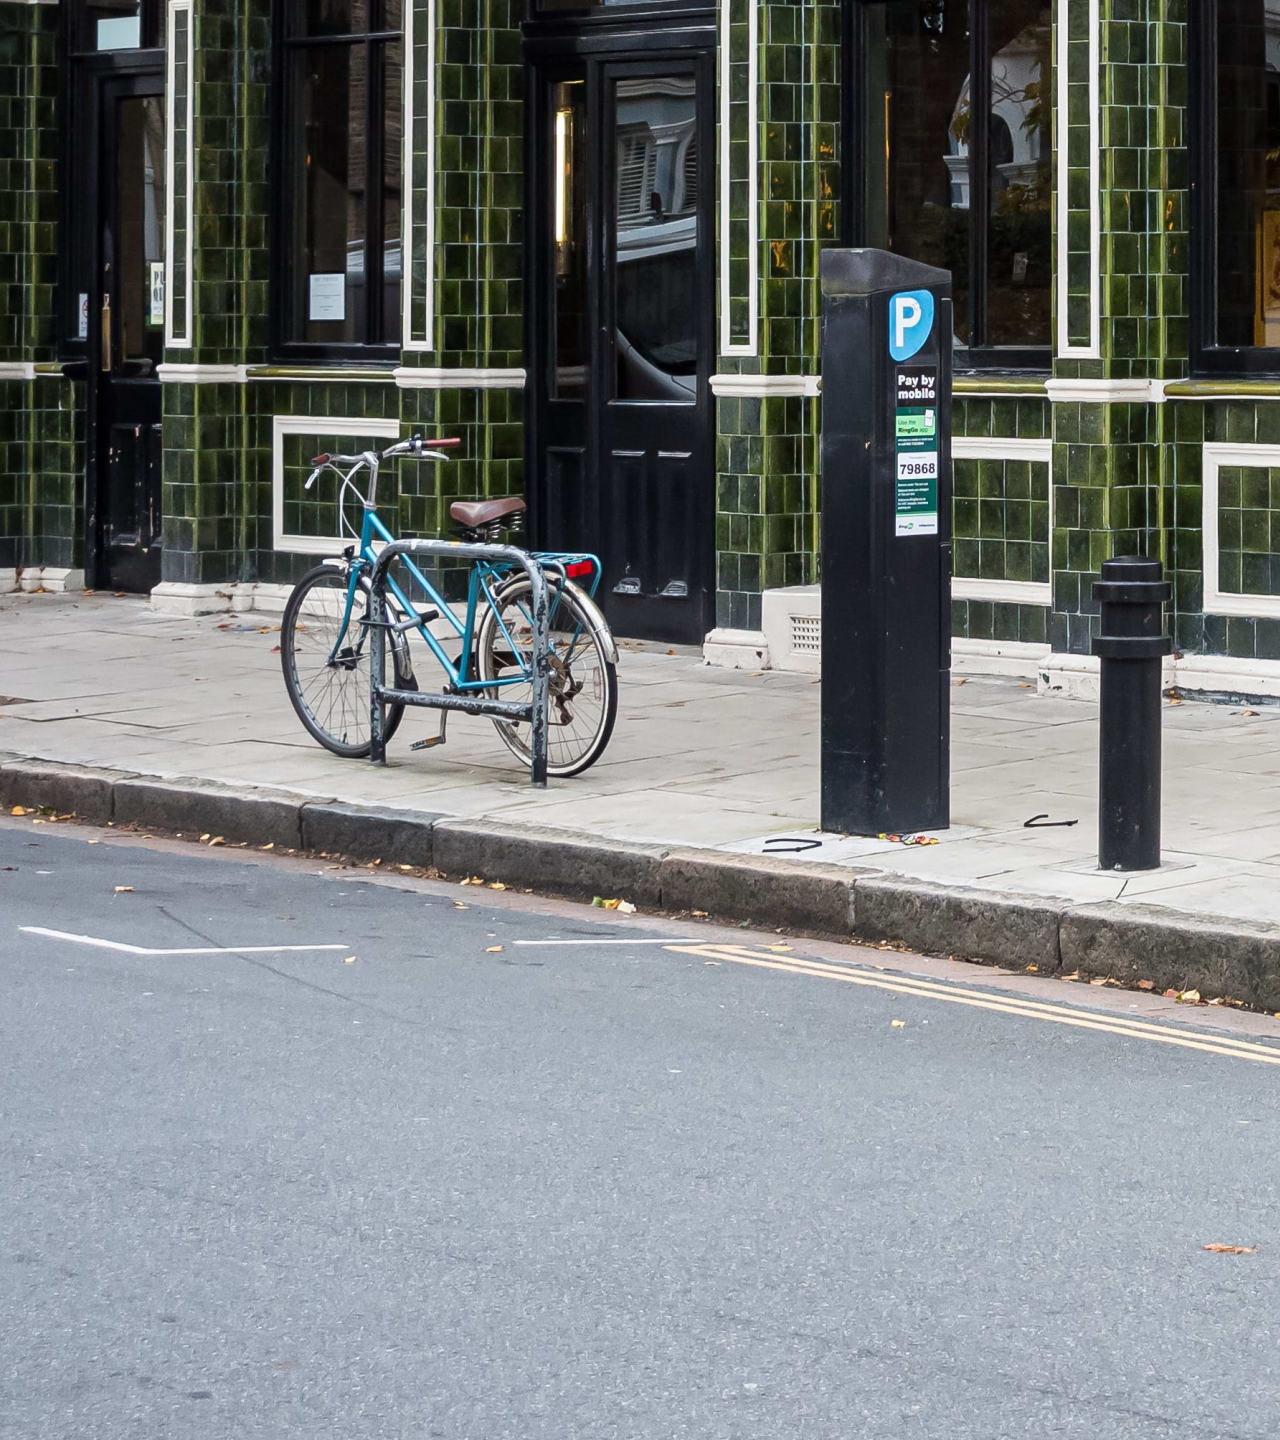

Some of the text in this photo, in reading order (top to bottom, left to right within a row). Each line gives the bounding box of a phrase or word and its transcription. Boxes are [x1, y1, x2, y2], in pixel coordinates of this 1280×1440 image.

[895, 297, 922, 347] P
[898, 374, 935, 388] Pay by
[898, 388, 936, 399] mobile
[900, 463, 936, 475] 79868
